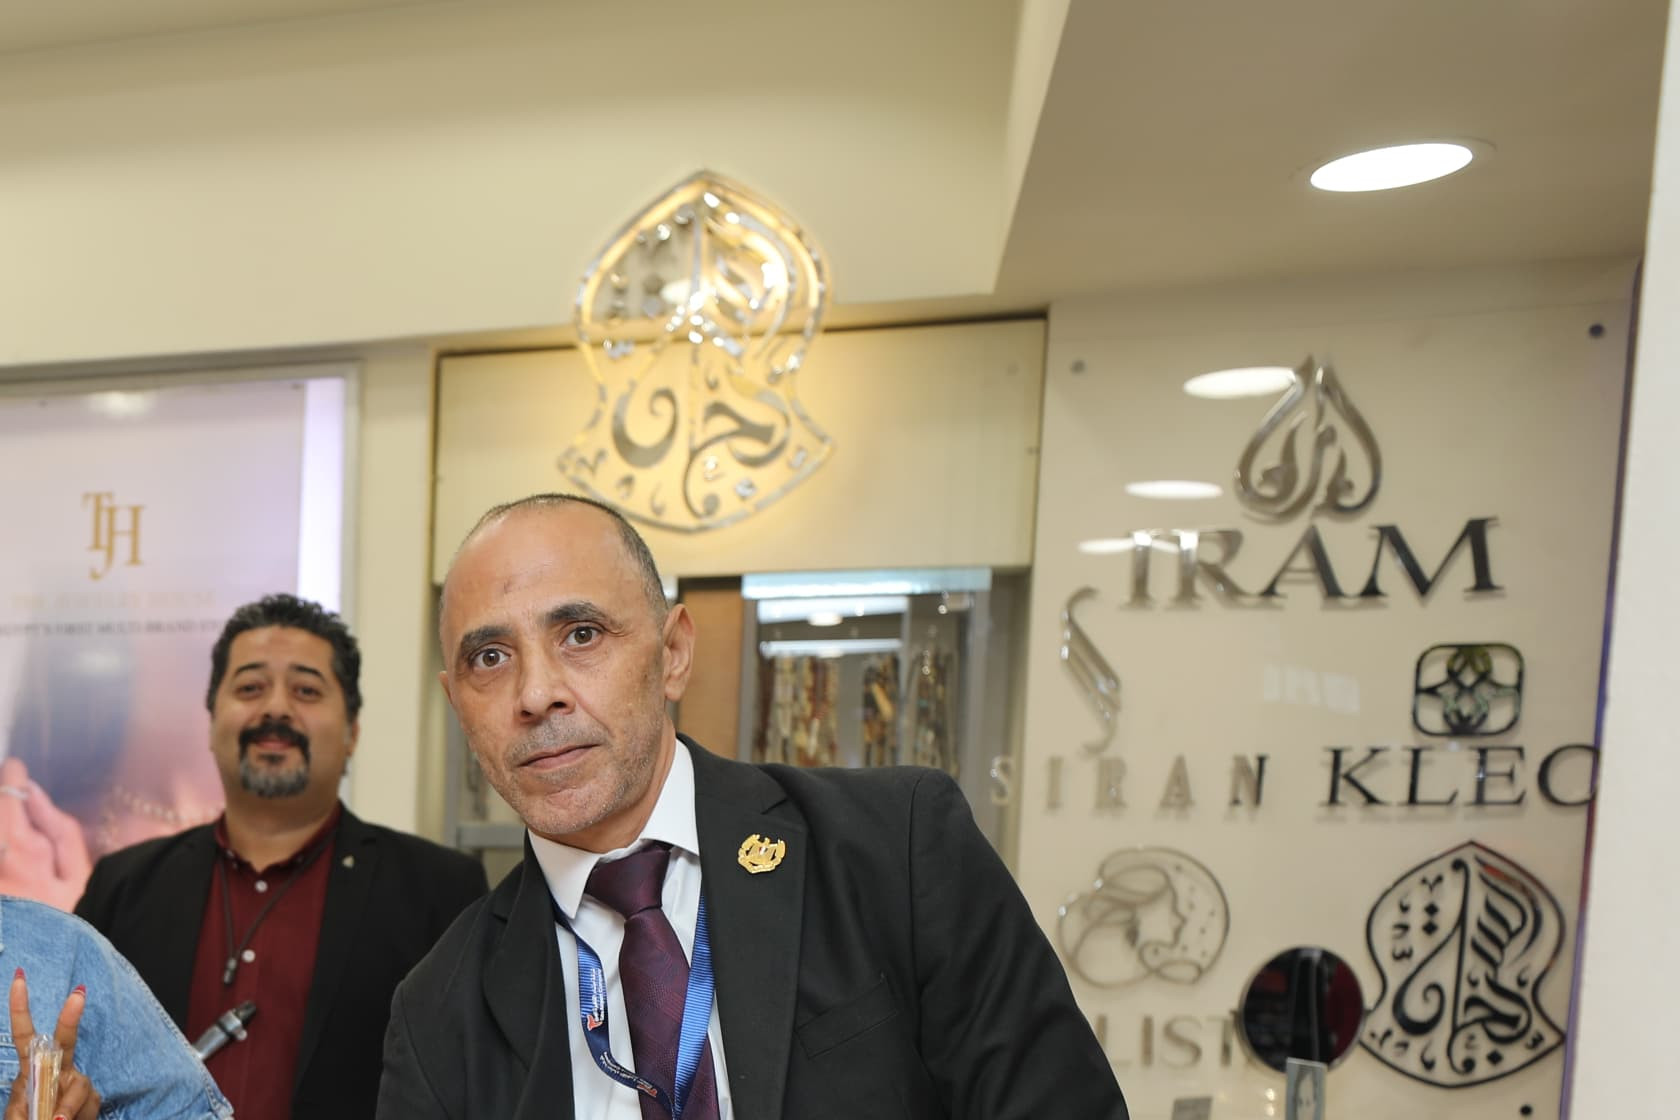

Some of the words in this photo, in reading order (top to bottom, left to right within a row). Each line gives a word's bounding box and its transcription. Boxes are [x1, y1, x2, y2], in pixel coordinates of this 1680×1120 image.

[82, 491, 146, 581] TJH
[1124, 517, 1503, 602] IRAM
[990, 754, 1269, 808] SIRAN
[1093, 1011, 1238, 1070] LIST
